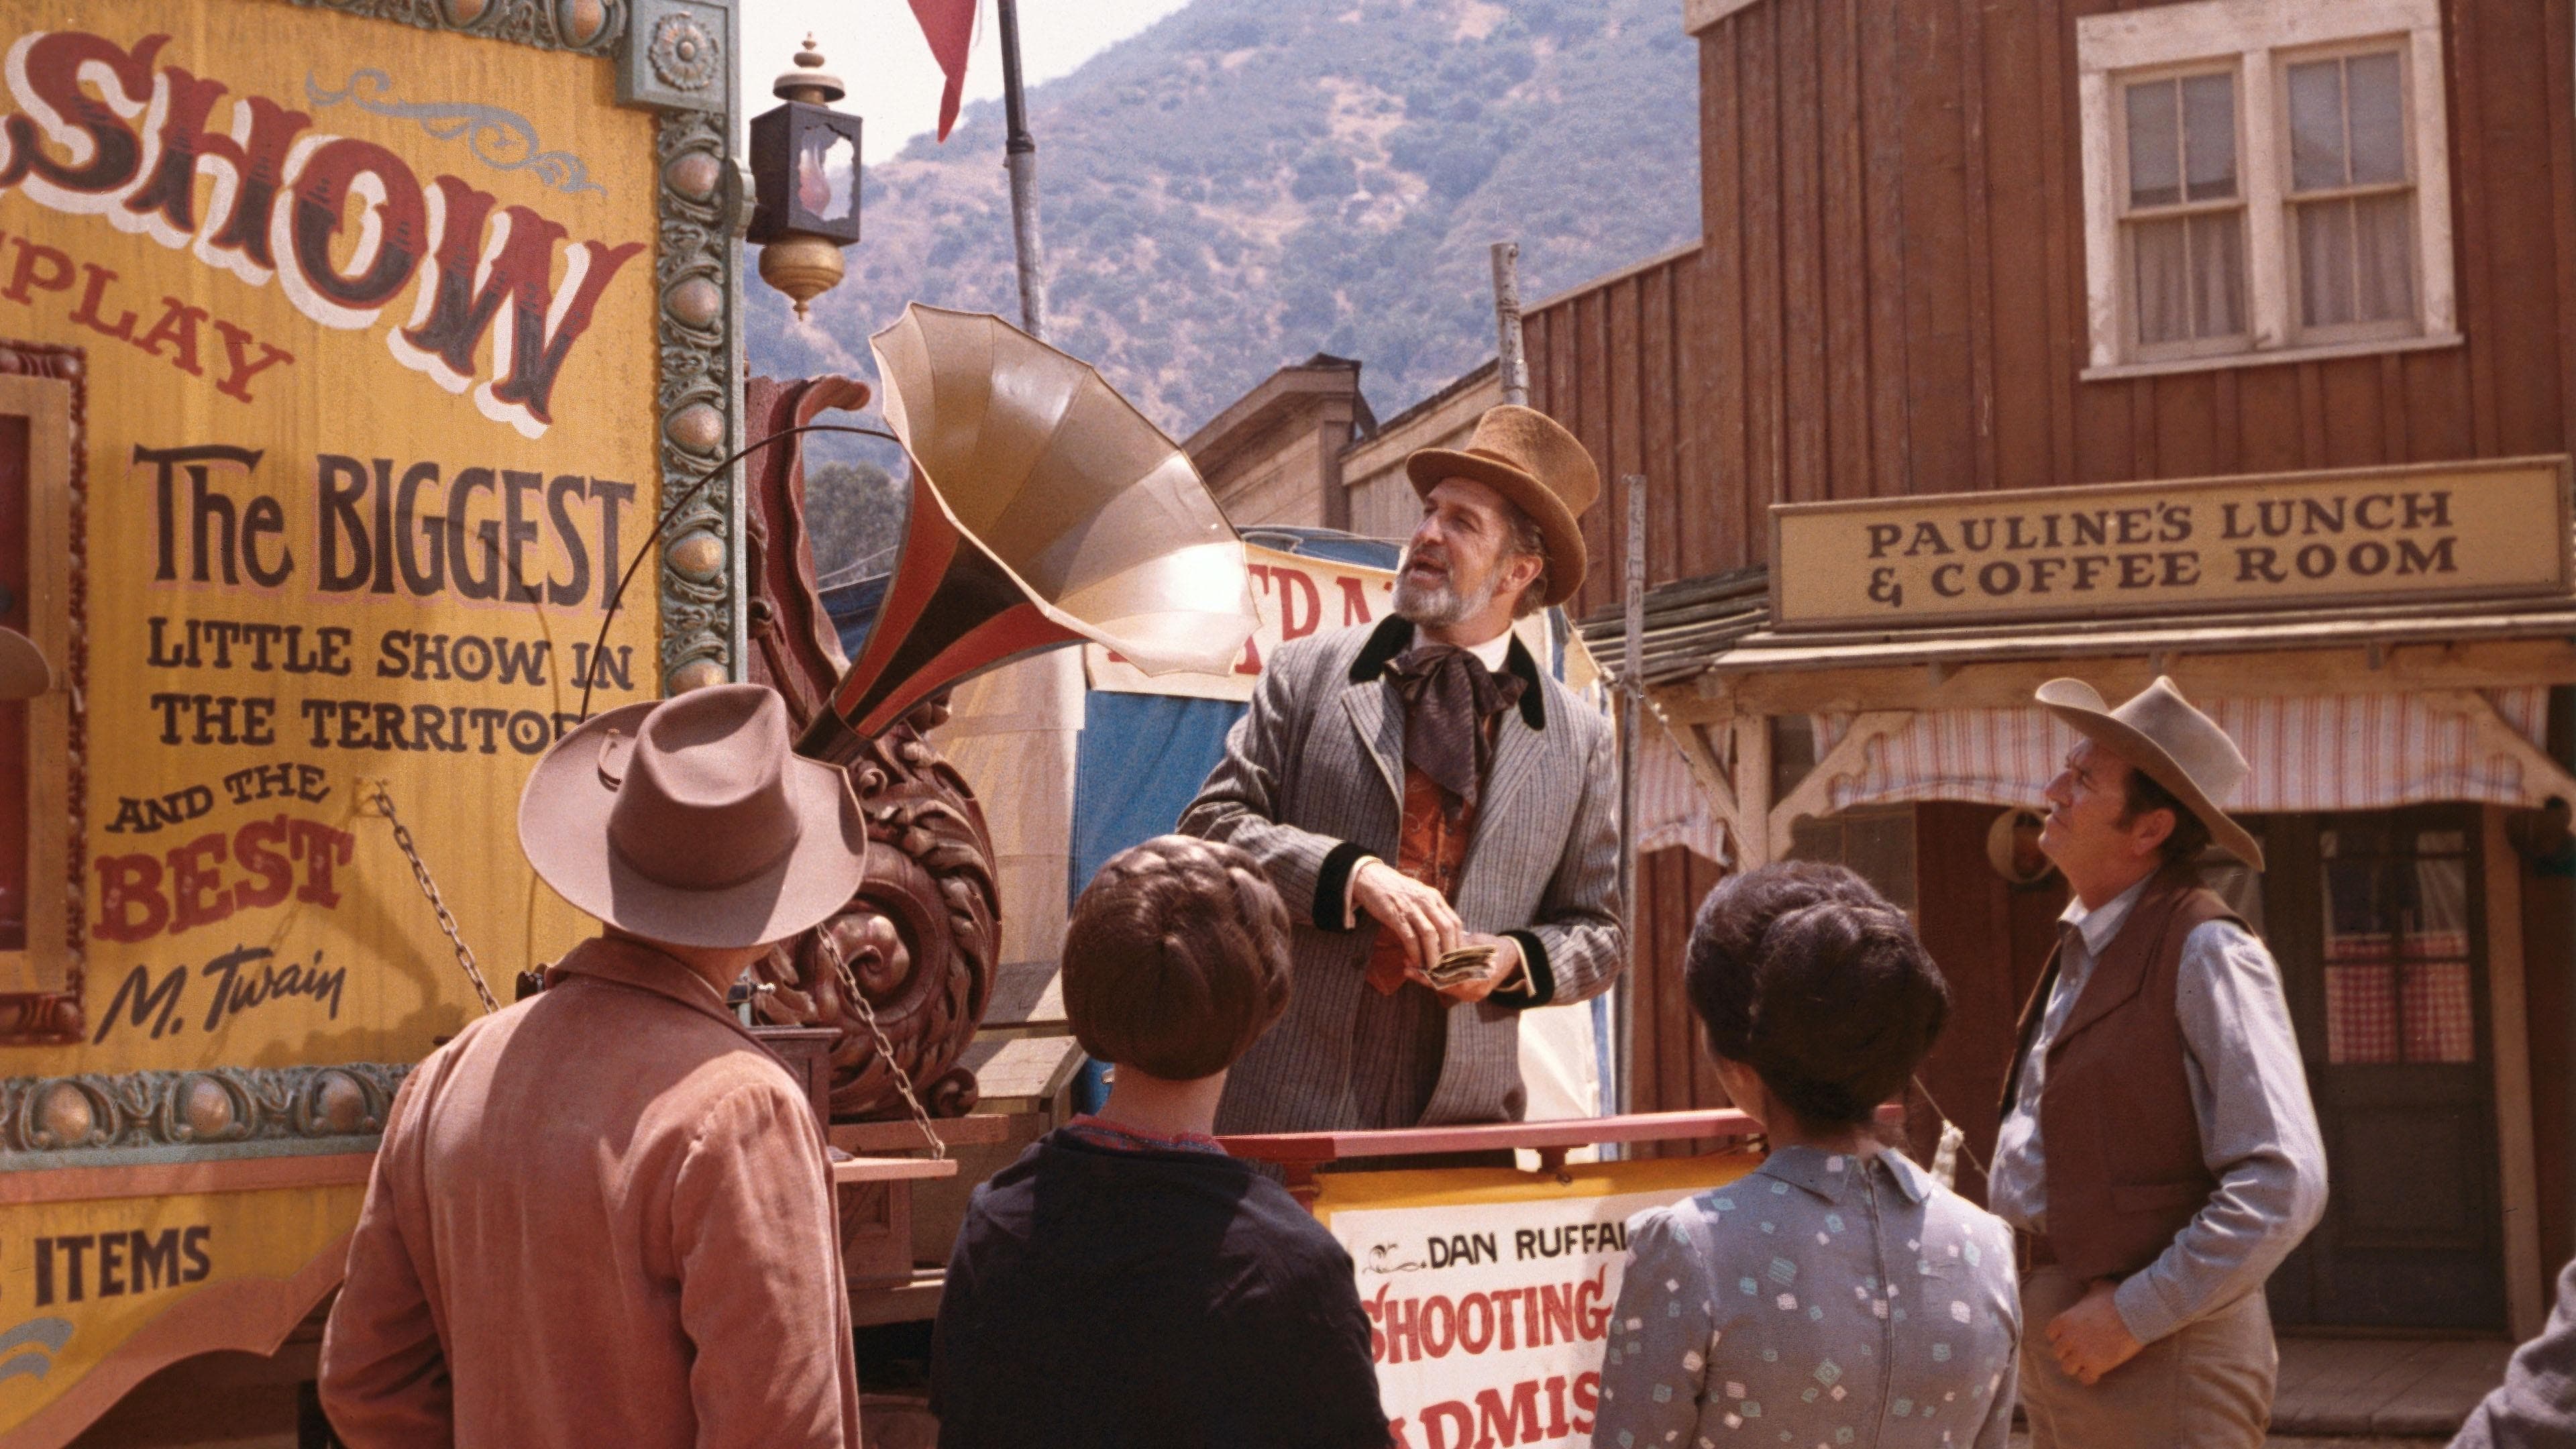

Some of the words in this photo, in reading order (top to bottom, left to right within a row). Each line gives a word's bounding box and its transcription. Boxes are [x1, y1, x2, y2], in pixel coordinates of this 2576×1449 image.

[1, 31, 645, 439] SHOW
[0, 230, 295, 403] PLAY
[133, 443, 294, 588] The
[317, 454, 636, 610] BIGGEST
[1867, 500, 2194, 558] PAULINE'S
[2220, 490, 2453, 539] LUNCH
[1867, 567, 1902, 608] &
[1931, 551, 2201, 597] COFFEE
[2235, 537, 2459, 583] ROOM
[146, 616, 351, 676] LITTLE
[376, 629, 551, 686] SHOW
[571, 642, 635, 690] IN
[151, 694, 275, 746] THE
[301, 699, 599, 755] TERRITO
[105, 785, 213, 834] AND
[223, 762, 331, 804] THE
[92, 812, 355, 943] BEST
[93, 963, 187, 1045] M.
[203, 943, 346, 1032] Twain
[34, 1226, 211, 1307] ITEMS
[1428, 1232, 1497, 1269] DAN
